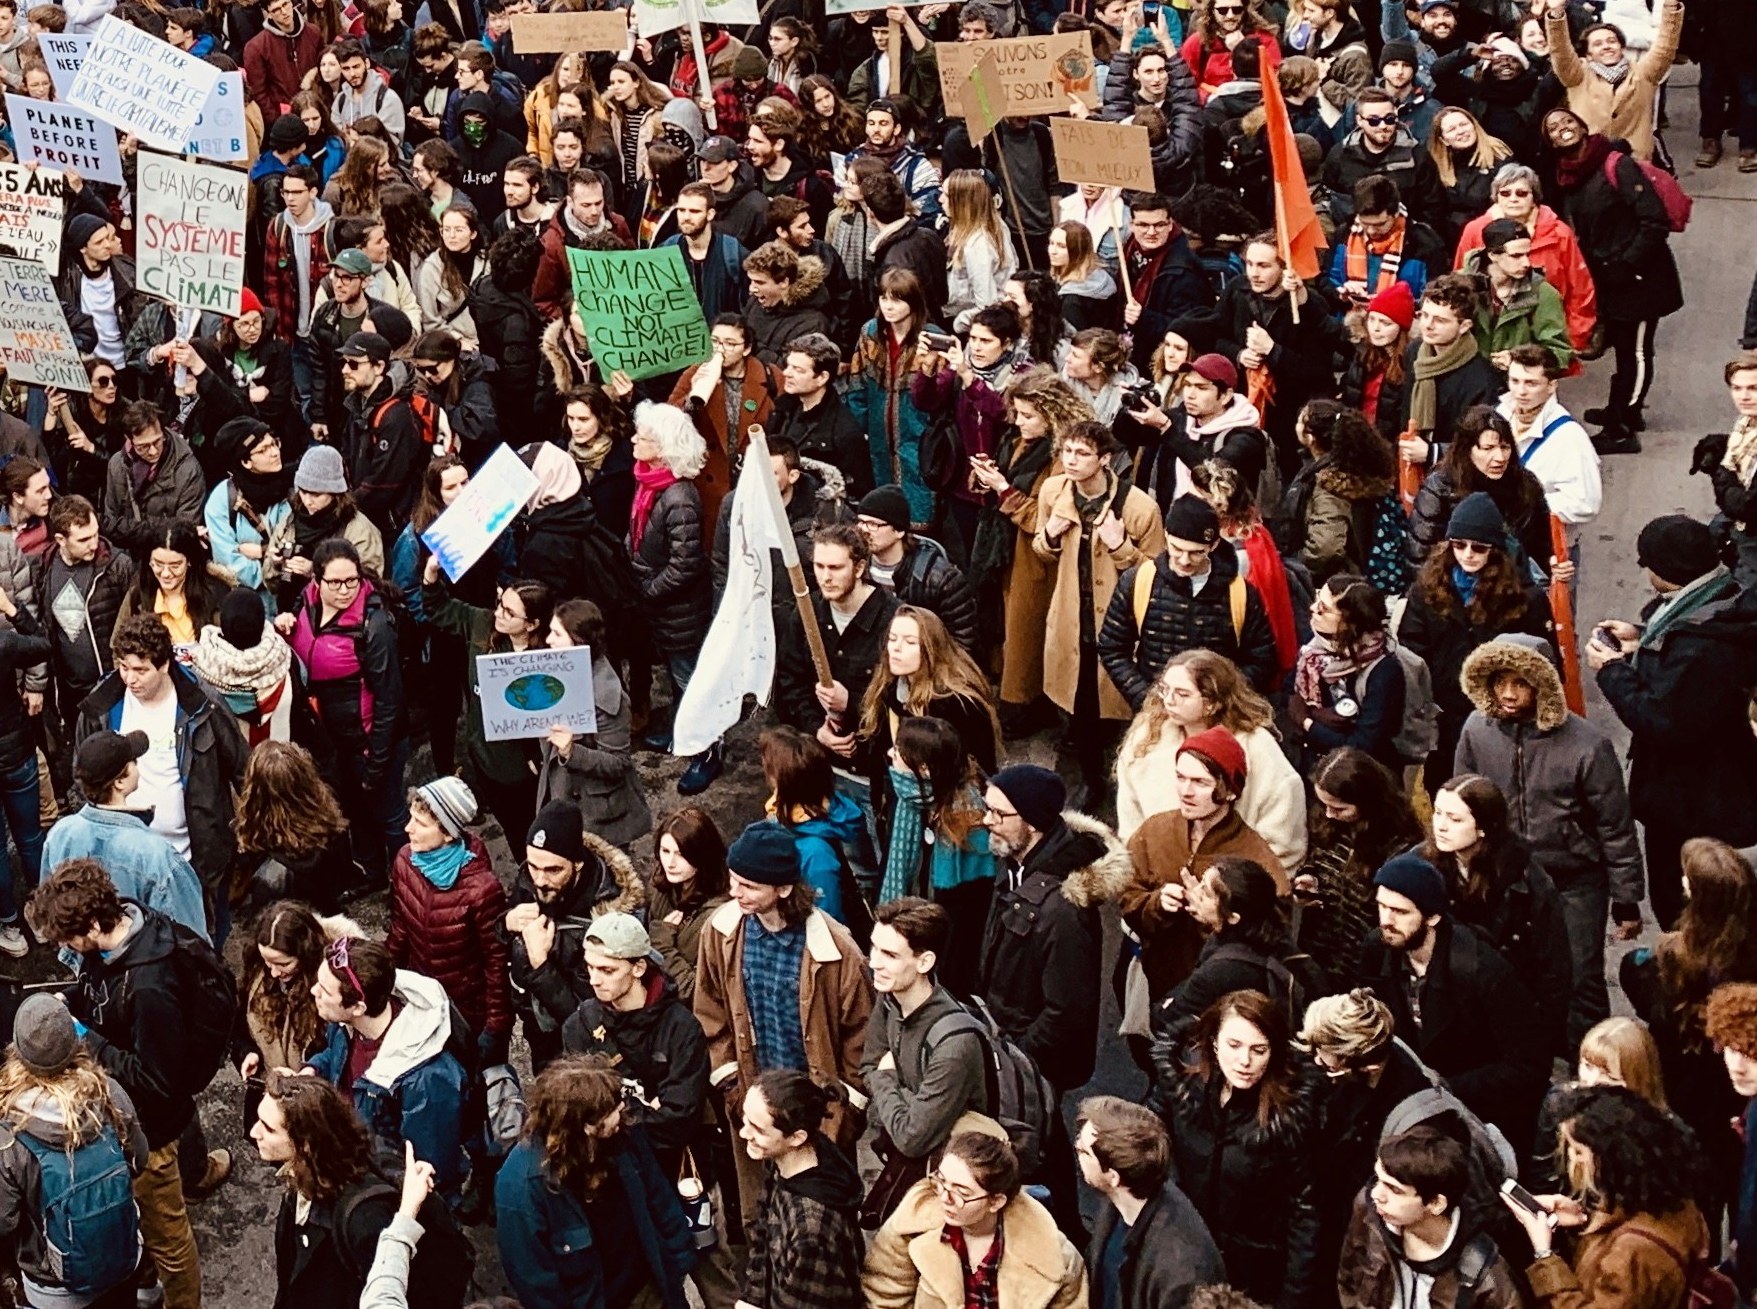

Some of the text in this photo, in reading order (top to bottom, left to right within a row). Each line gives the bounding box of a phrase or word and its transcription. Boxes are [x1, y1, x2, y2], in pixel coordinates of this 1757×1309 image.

[48, 40, 79, 54] THIS
[100, 19, 125, 44] LA
[159, 47, 190, 72] POUR
[90, 43, 206, 108] NOTRE PLANÈTE
[131, 81, 155, 103] UNE
[26, 108, 96, 133] PLANET
[31, 127, 99, 152] BEFORE
[1060, 124, 1129, 151] FAIS DE
[33, 145, 101, 171] PROFIT
[1061, 157, 1142, 182] TON MIEUX
[6, 170, 19, 191] 5
[27, 170, 64, 198] ANS
[143, 162, 247, 211] CHANGEONS
[181, 201, 211, 225] LE
[144, 212, 244, 259] SYSTÈME
[8, 260, 53, 286] TERRE
[160, 249, 236, 282] PAS LE
[571, 252, 683, 290] HUMAN
[1, 298, 47, 317] comme
[594, 316, 704, 348] CLIMATE
[624, 310, 667, 333] NOT
[2, 346, 37, 365] FAUT
[603, 334, 706, 371] CHANGE!
[487, 661, 576, 679] IS CHANGING
[489, 651, 569, 667] THE CLIMATE
[489, 709, 595, 735] WHY WE?
